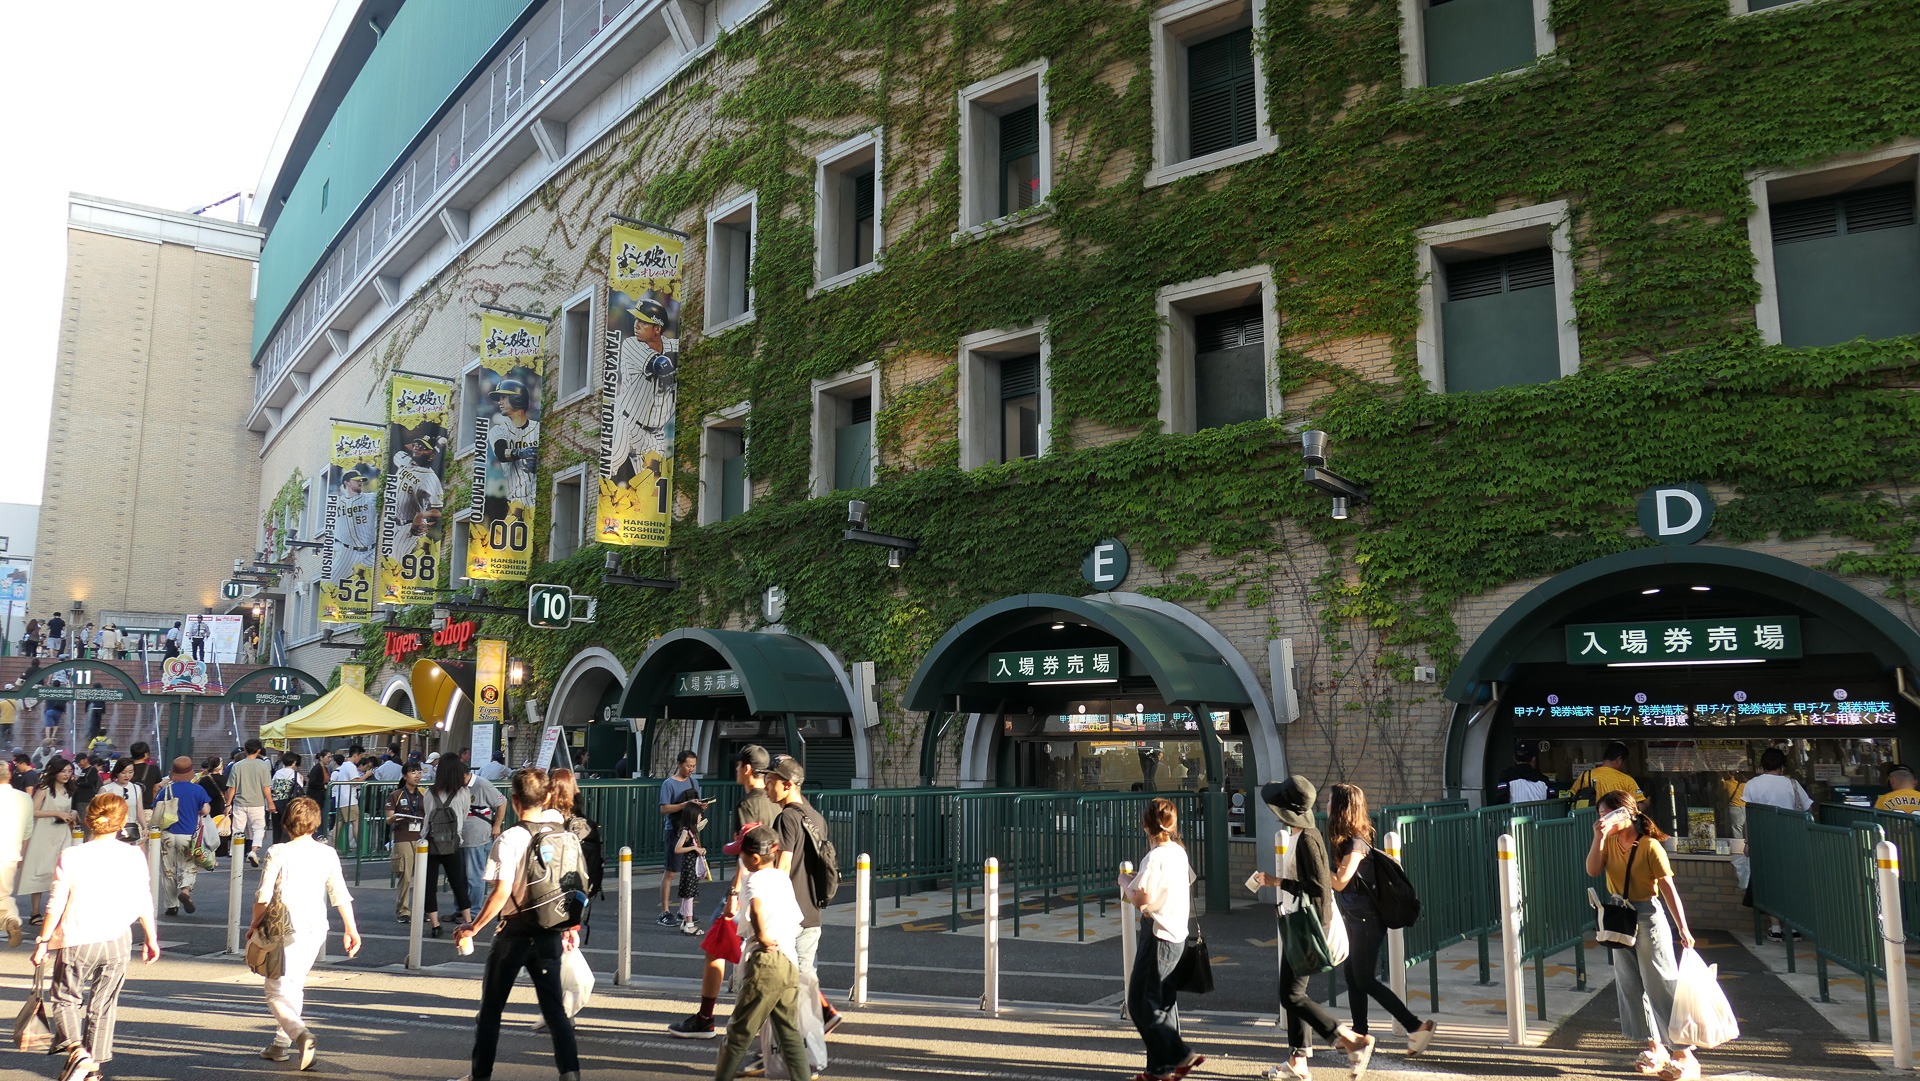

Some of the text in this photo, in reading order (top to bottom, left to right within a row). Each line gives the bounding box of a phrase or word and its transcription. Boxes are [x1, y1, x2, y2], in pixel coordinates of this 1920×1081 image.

[600, 330, 621, 479] TAKASHI TORITANI
[470, 416, 489, 523] HIROKI UEMOTO
[655, 477, 668, 514] 1
[355, 515, 368, 525] 52
[382, 473, 398, 558] RAFAEL DOLIS
[1655, 489, 1702, 536] D
[623, 518, 666, 528] HANSHIN
[623, 525, 666, 535] KOSHIEN
[321, 495, 338, 580] PIERCE JOHNSON
[490, 519, 528, 551] 00
[622, 532, 665, 541] STADIUM
[401, 554, 435, 581] 98
[490, 557, 528, 565] HANSHIN
[490, 563, 527, 571] KOSHIEN
[1095, 544, 1114, 582] E
[490, 568, 527, 576] STADIUM
[228, 583, 239, 597] 11
[338, 579, 369, 603] 52
[542, 593, 566, 620] 10
[768, 586, 778, 615] F
[1581, 624, 1784, 655] 入場券売場
[996, 653, 1110, 677] 入場券売場
[76, 670, 91, 685] 11
[274, 676, 287, 691] 11
[679, 674, 740, 692] 入場券売場
[1514, 705, 1594, 718] 甲チケ 発券端末
[1600, 704, 1685, 716] 甲チケ 発券端末
[1696, 702, 1788, 715] 甲チケ 発券端末
[1793, 701, 1890, 714] 甲チケ 発券端末
[1539, 741, 1550, 751] 16
[1861, 743, 1873, 753] 13
